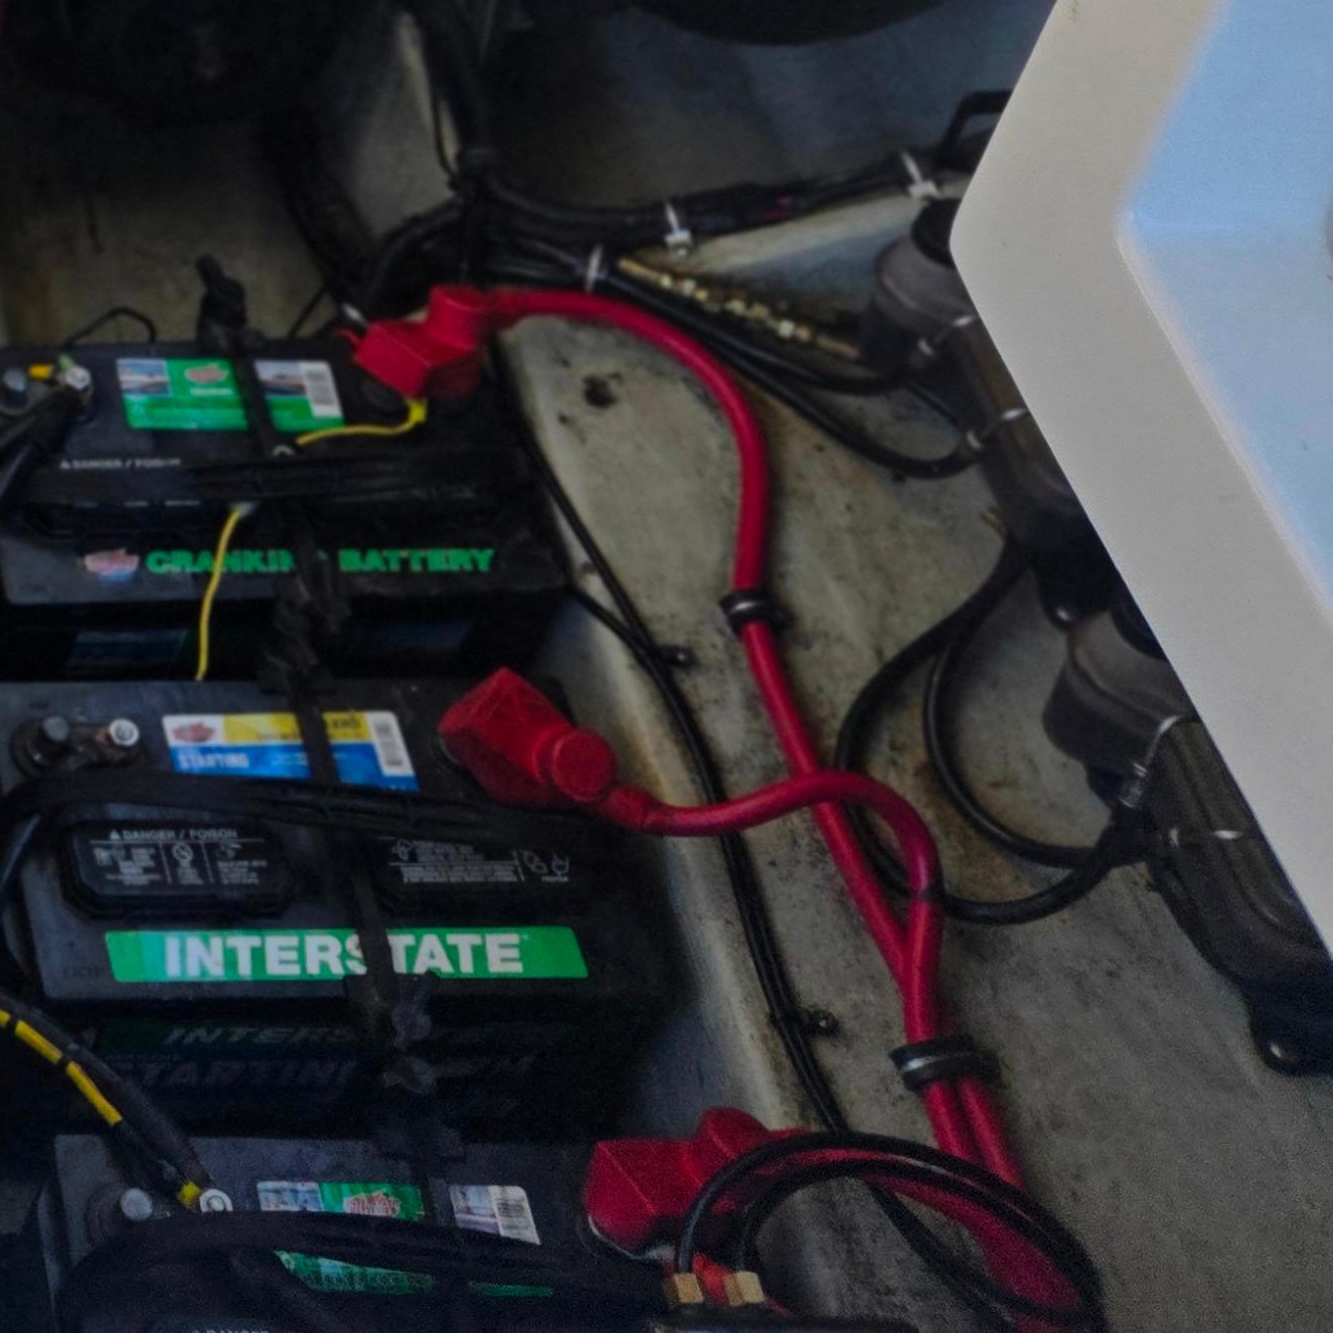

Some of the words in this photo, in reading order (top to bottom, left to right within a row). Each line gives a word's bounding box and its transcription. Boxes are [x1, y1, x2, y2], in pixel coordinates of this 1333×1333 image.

[144, 548, 327, 574] CRANKIN
[338, 547, 497, 573] BATTERY
[122, 829, 176, 840] DANGER
[189, 828, 237, 839] POISON
